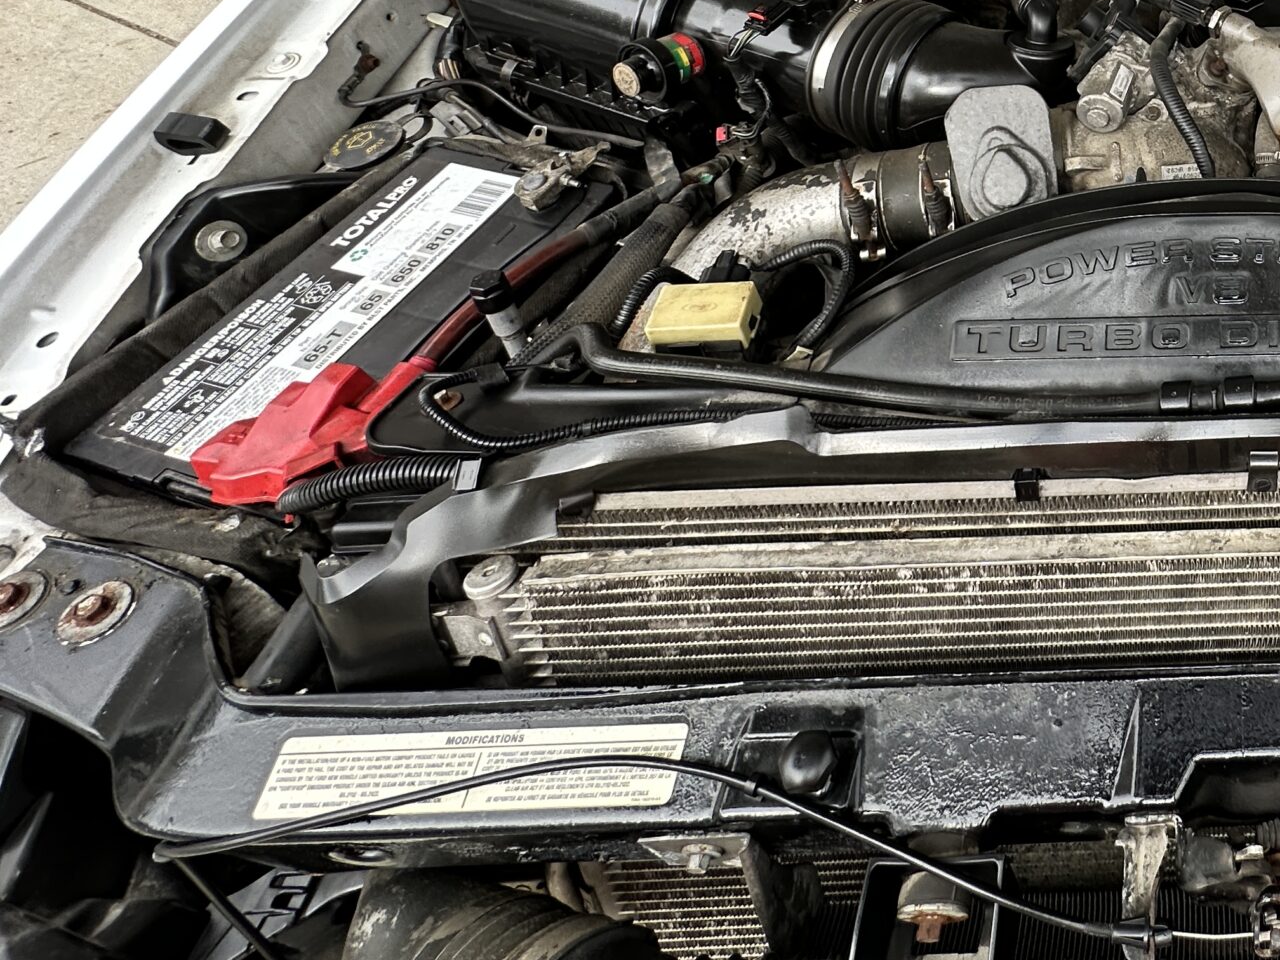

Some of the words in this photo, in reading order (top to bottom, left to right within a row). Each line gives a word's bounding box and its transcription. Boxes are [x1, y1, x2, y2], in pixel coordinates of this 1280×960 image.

[328, 175, 421, 250] TOTALPRO
[424, 227, 456, 250] 810
[389, 258, 423, 283] 650
[1002, 239, 1193, 298] POWER
[357, 292, 384, 311] 65
[1175, 274, 1248, 305] V8
[168, 298, 266, 377] DANGER/POISON
[300, 328, 345, 363] 65-T
[314, 330, 359, 369] DISTRIBUTED
[356, 321, 368, 330] BY
[366, 306, 385, 321] BEST
[966, 322, 1190, 354] TURBO
[165, 431, 185, 446] KEEP
[180, 420, 197, 433] OUT
[194, 412, 206, 421] OF
[203, 402, 218, 413] THE
[215, 385, 238, 403] REACH
[234, 378, 246, 386] OF
[279, 335, 294, 346] NOT
[445, 734, 525, 745] MODIFICATIONS
